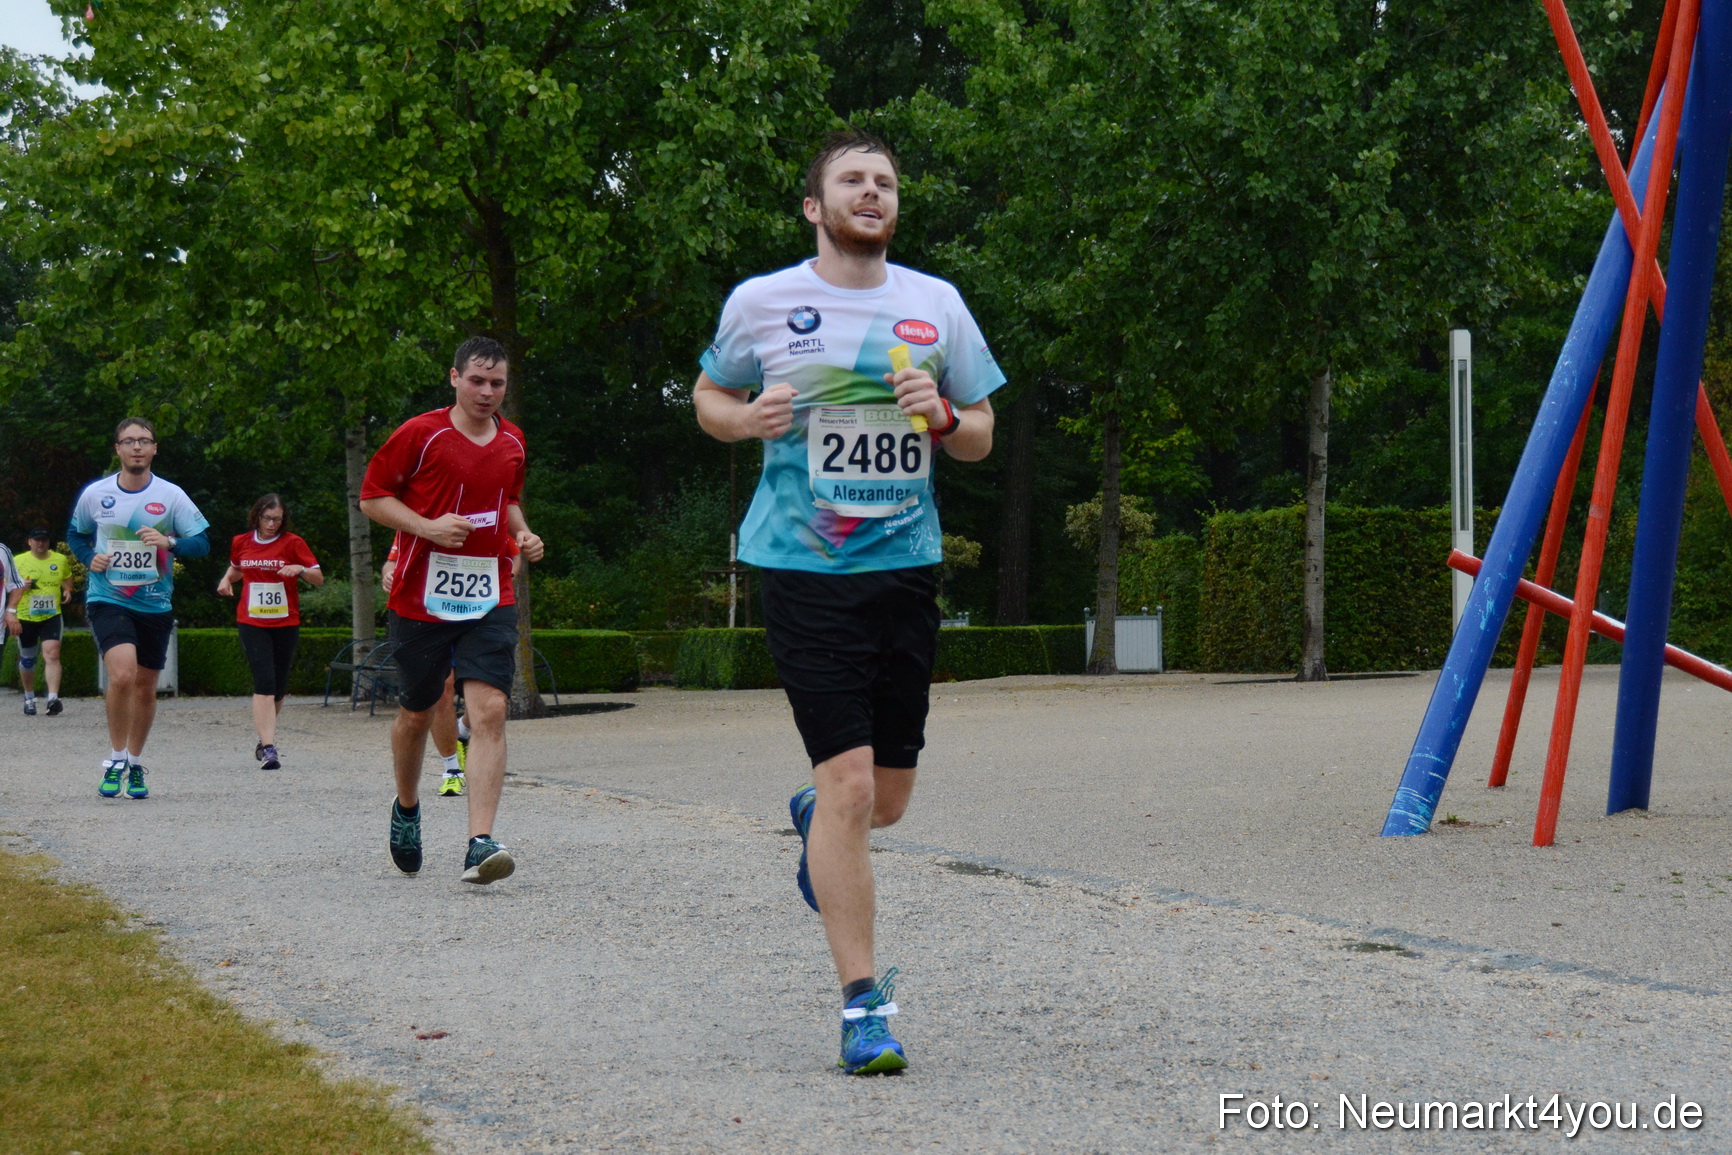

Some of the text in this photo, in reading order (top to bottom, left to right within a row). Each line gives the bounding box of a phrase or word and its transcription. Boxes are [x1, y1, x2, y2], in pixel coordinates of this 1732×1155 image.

[900, 325, 936, 339] Hervis
[788, 339, 825, 350] PARTL
[789, 347, 825, 357] Neumarkt
[864, 409, 911, 422] BOC
[822, 432, 922, 474] 2486
[833, 485, 911, 501] Alexander
[113, 551, 152, 568] 2382
[120, 572, 147, 580] Thomas
[434, 570, 492, 598] 2523
[33, 600, 54, 609] 2911
[258, 592, 282, 605] 136
[442, 602, 483, 613] Matthias
